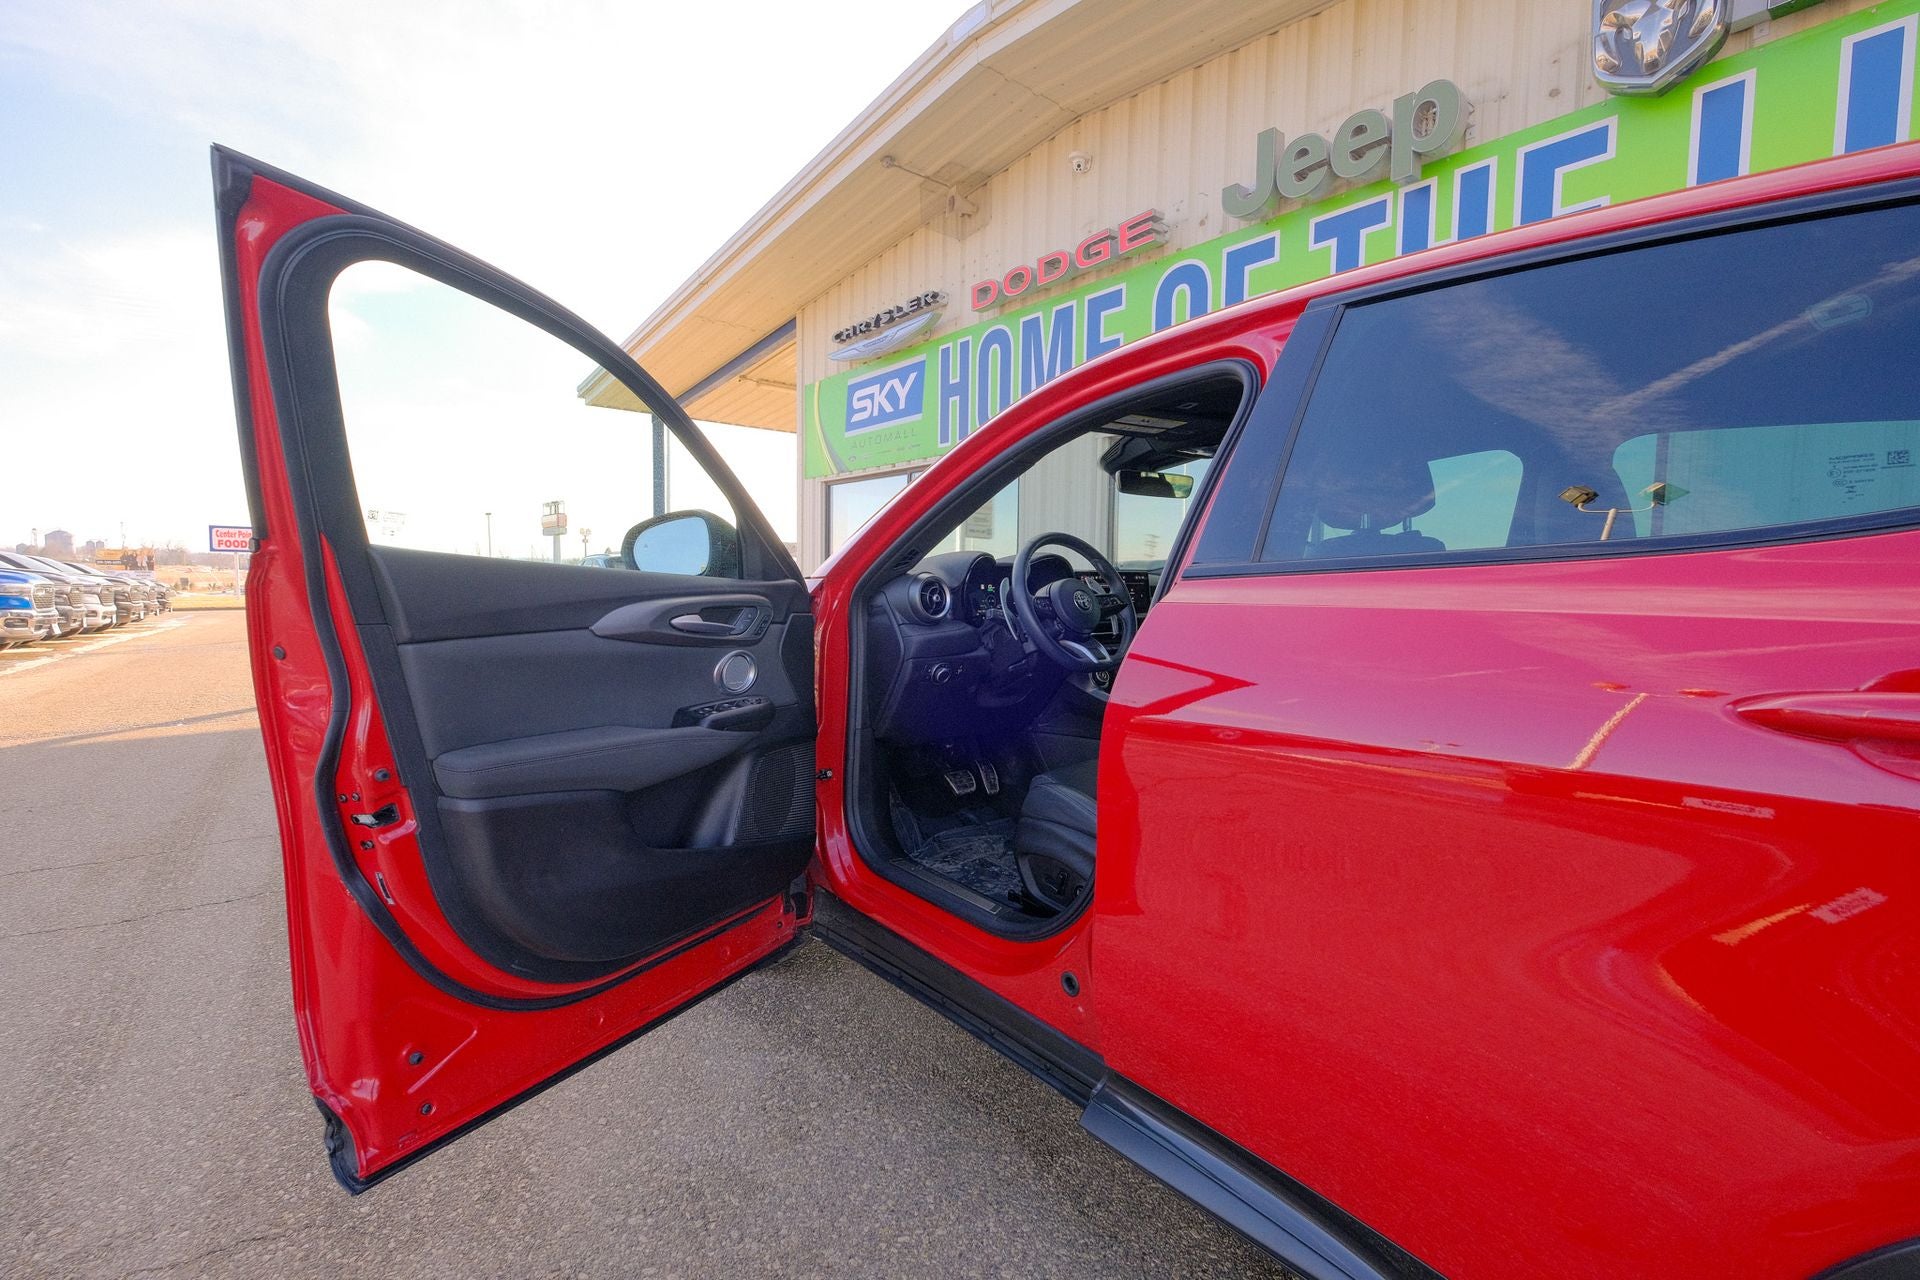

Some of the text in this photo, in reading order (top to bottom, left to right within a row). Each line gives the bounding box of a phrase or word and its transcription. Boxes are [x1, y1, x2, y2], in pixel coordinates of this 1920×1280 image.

[1222, 79, 1464, 218] Jeep
[971, 209, 1160, 312] DODGE
[832, 290, 944, 343] CHRYSLER
[938, 283, 1127, 448] HOME
[851, 372, 917, 423] SKY
[851, 427, 918, 449] AUTOMALL
[215, 529, 252, 538] Center Poin
